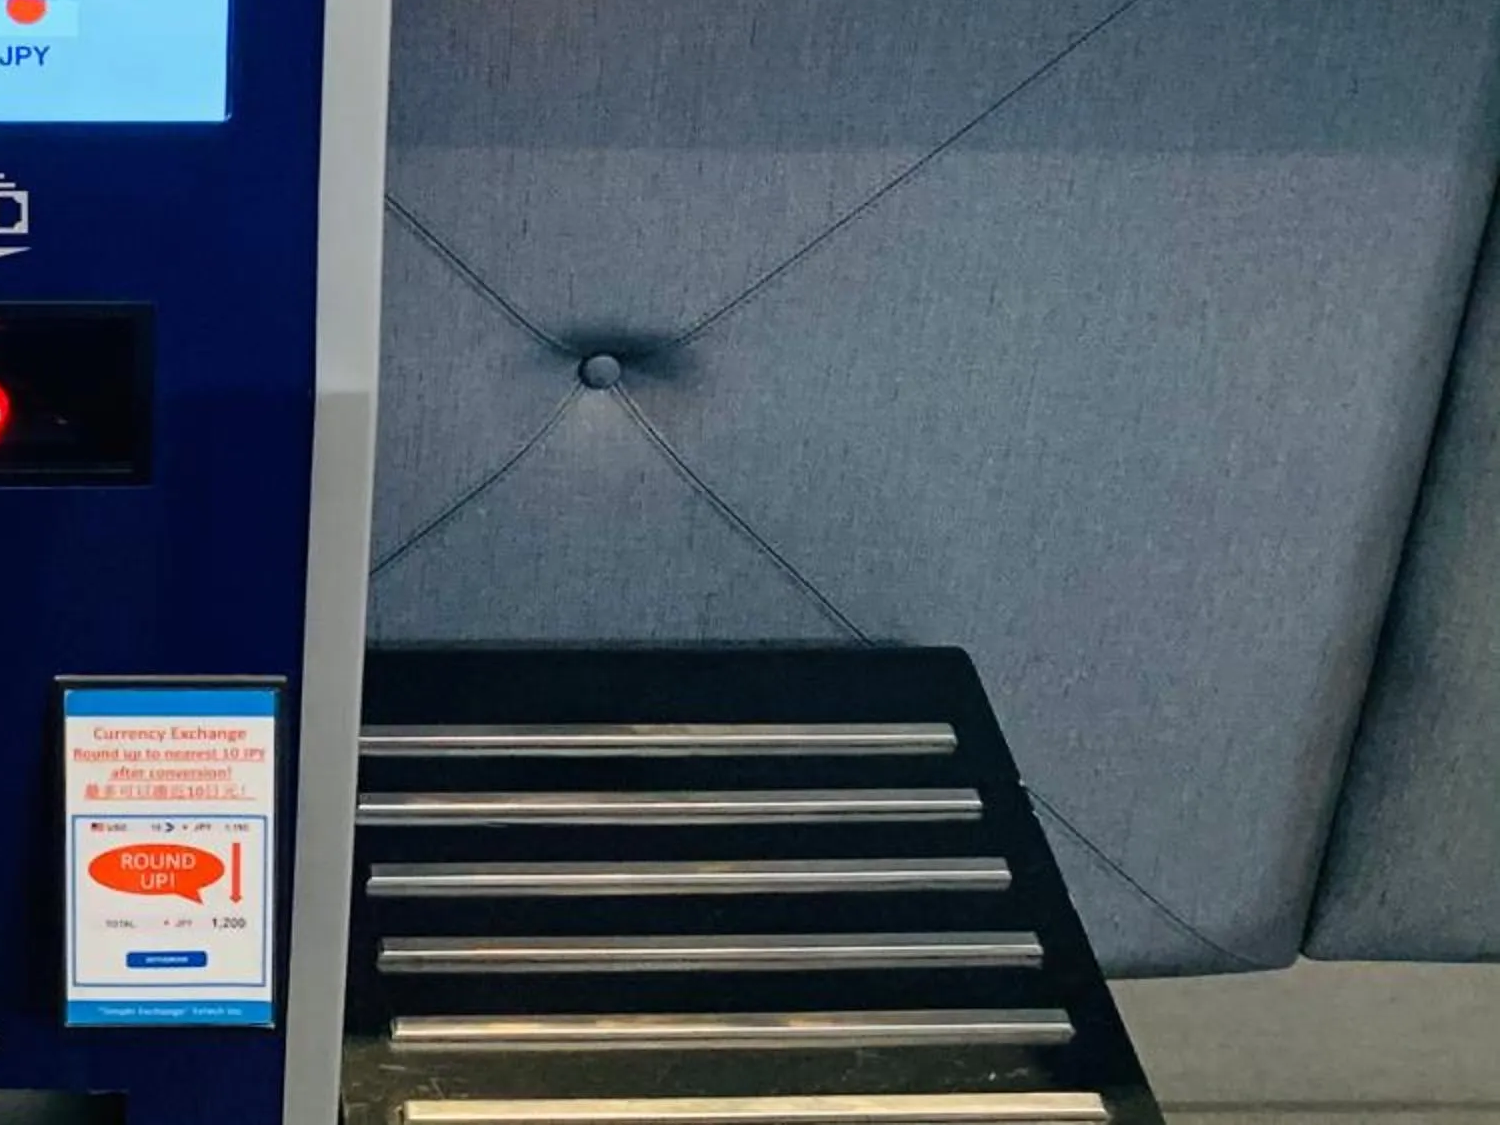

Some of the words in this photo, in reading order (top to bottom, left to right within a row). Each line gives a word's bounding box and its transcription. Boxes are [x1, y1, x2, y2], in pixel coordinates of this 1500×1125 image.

[93, 727, 165, 743] Currency
[171, 727, 247, 743] Exchange
[73, 748, 118, 760] Round
[120, 854, 197, 870] ROUND
[140, 874, 176, 890] UP!
[211, 917, 247, 930] 1,200
